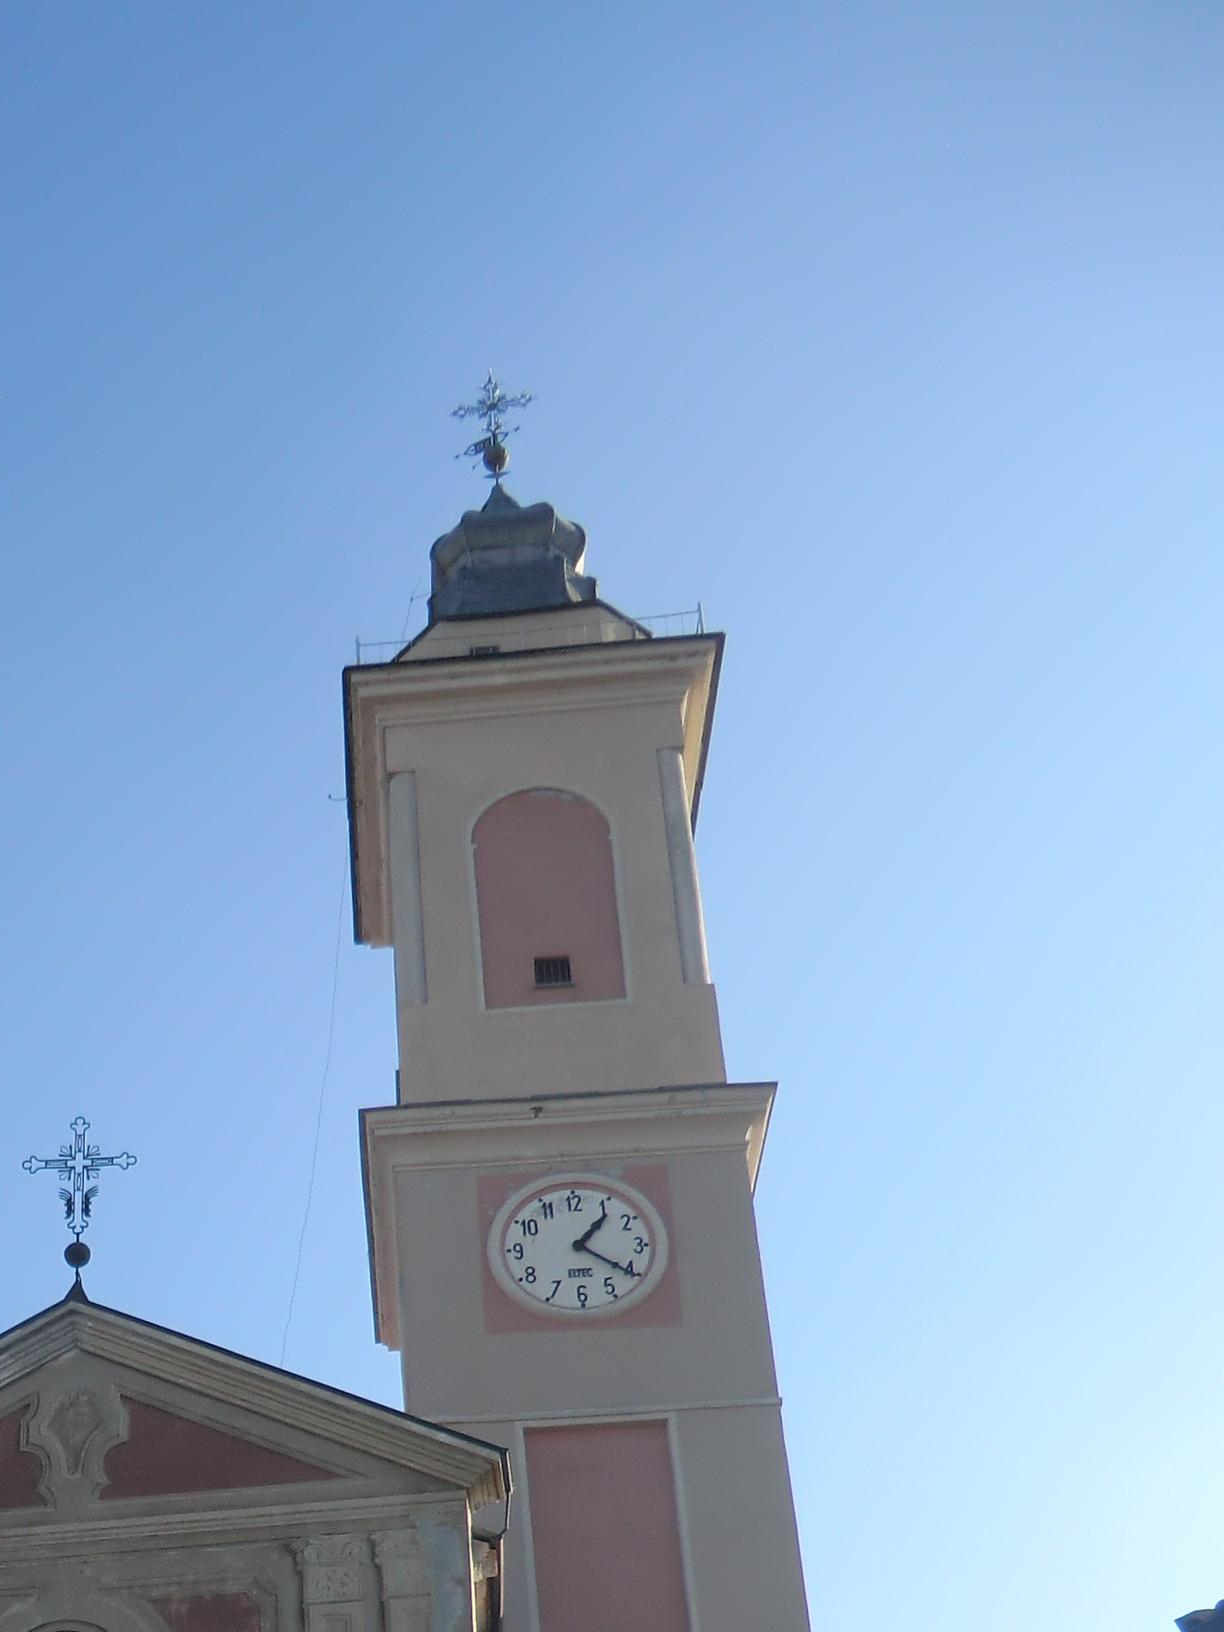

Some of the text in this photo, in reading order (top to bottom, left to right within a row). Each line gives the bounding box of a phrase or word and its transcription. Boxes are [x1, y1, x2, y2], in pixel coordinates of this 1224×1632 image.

[541, 1201, 554, 1219] 11
[565, 1194, 582, 1213] 12
[599, 1199, 607, 1216] 1
[520, 1218, 539, 1236] 10
[620, 1213, 632, 1231] 2
[512, 1242, 524, 1260] 9
[633, 1236, 644, 1254] 3
[524, 1266, 537, 1284] 8
[549, 1280, 562, 1299] 7
[576, 1284, 588, 1303] 6
[603, 1276, 615, 1295] 5
